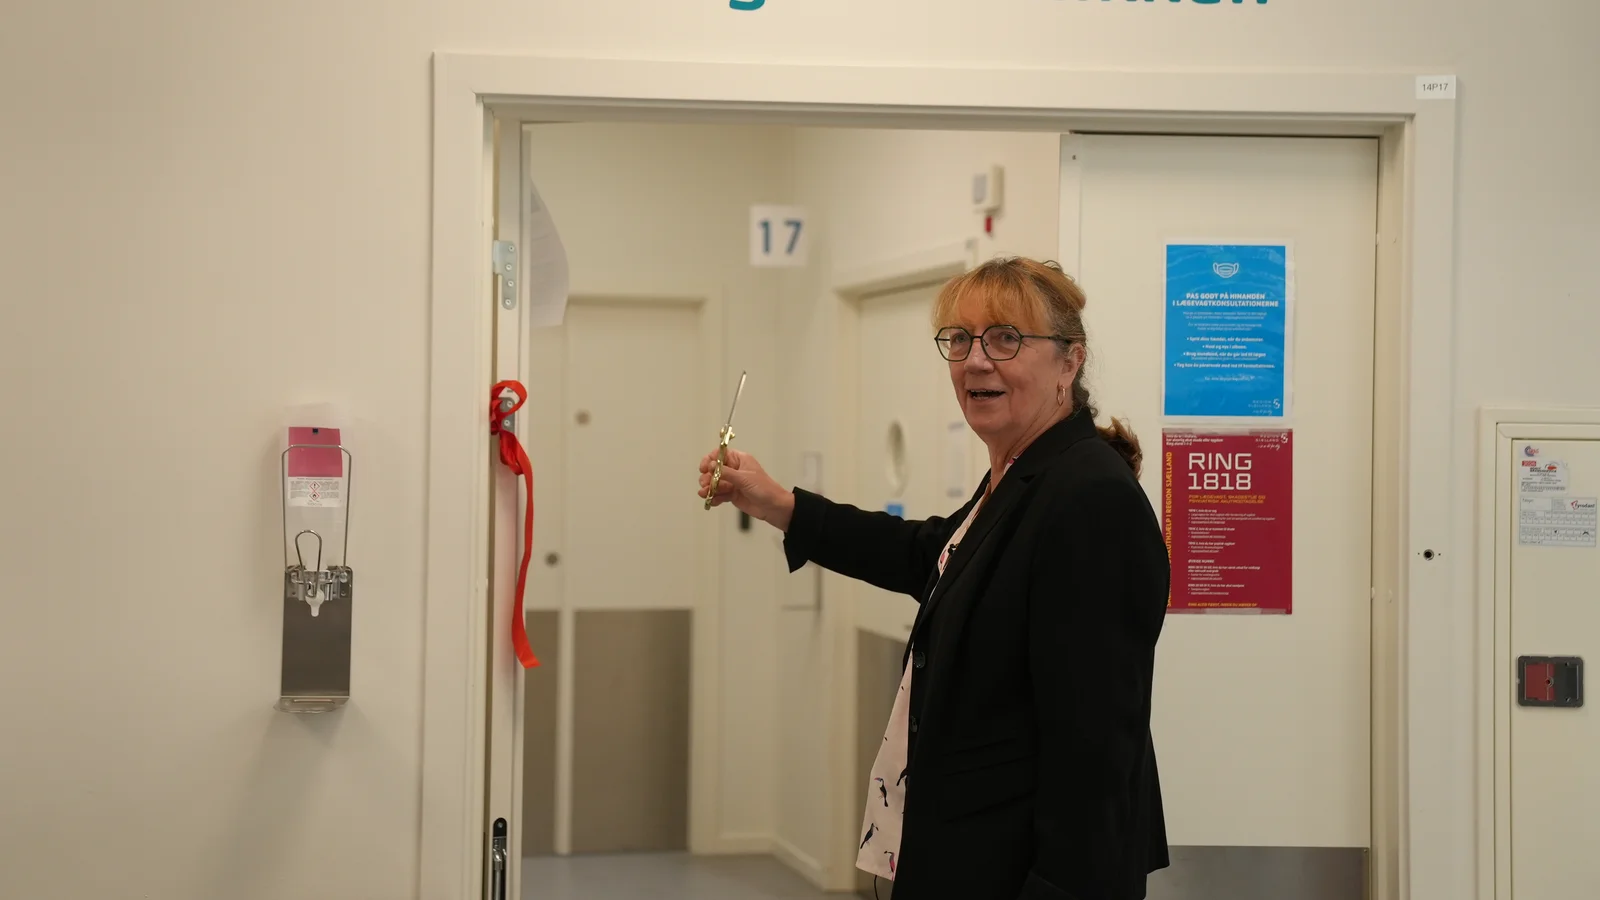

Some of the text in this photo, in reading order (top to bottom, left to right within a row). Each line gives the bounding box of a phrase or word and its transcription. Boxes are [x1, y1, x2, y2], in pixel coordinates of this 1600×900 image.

[1422, 83, 1449, 91] 14P17
[758, 219, 803, 255] 17
[1186, 292, 1199, 300] PAS
[1200, 292, 1219, 300] GODT
[1219, 291, 1229, 300] PÅ
[1188, 452, 1252, 470] RING
[1188, 473, 1252, 490] 1818
